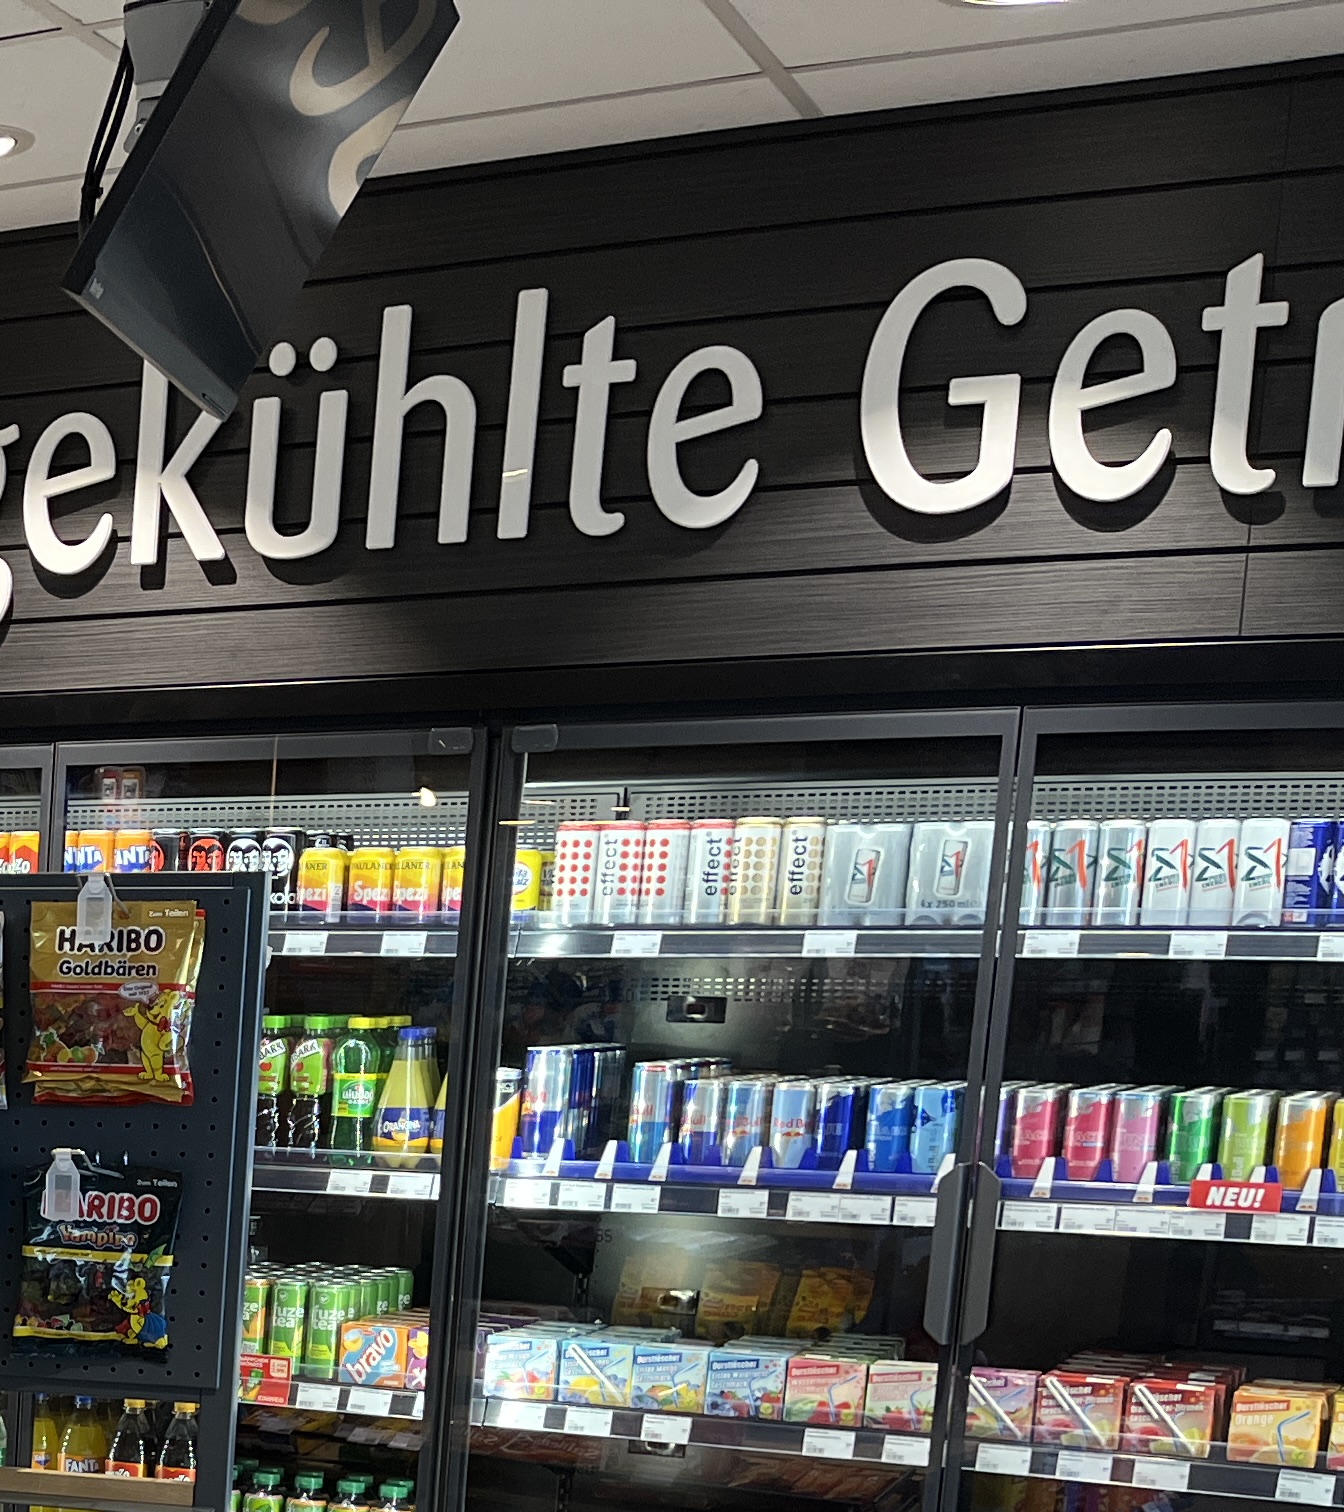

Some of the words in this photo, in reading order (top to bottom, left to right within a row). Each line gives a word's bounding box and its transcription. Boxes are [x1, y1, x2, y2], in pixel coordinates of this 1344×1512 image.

[704, 839, 723, 897] effect
[790, 836, 806, 896] effect
[354, 880, 390, 901] Spez
[58, 959, 157, 977] Goldbären
[74, 1193, 160, 1223] ARIBO
[1206, 1185, 1263, 1208] NEU!
[346, 1329, 395, 1384] bravo
[1235, 1412, 1275, 1428] Orange
